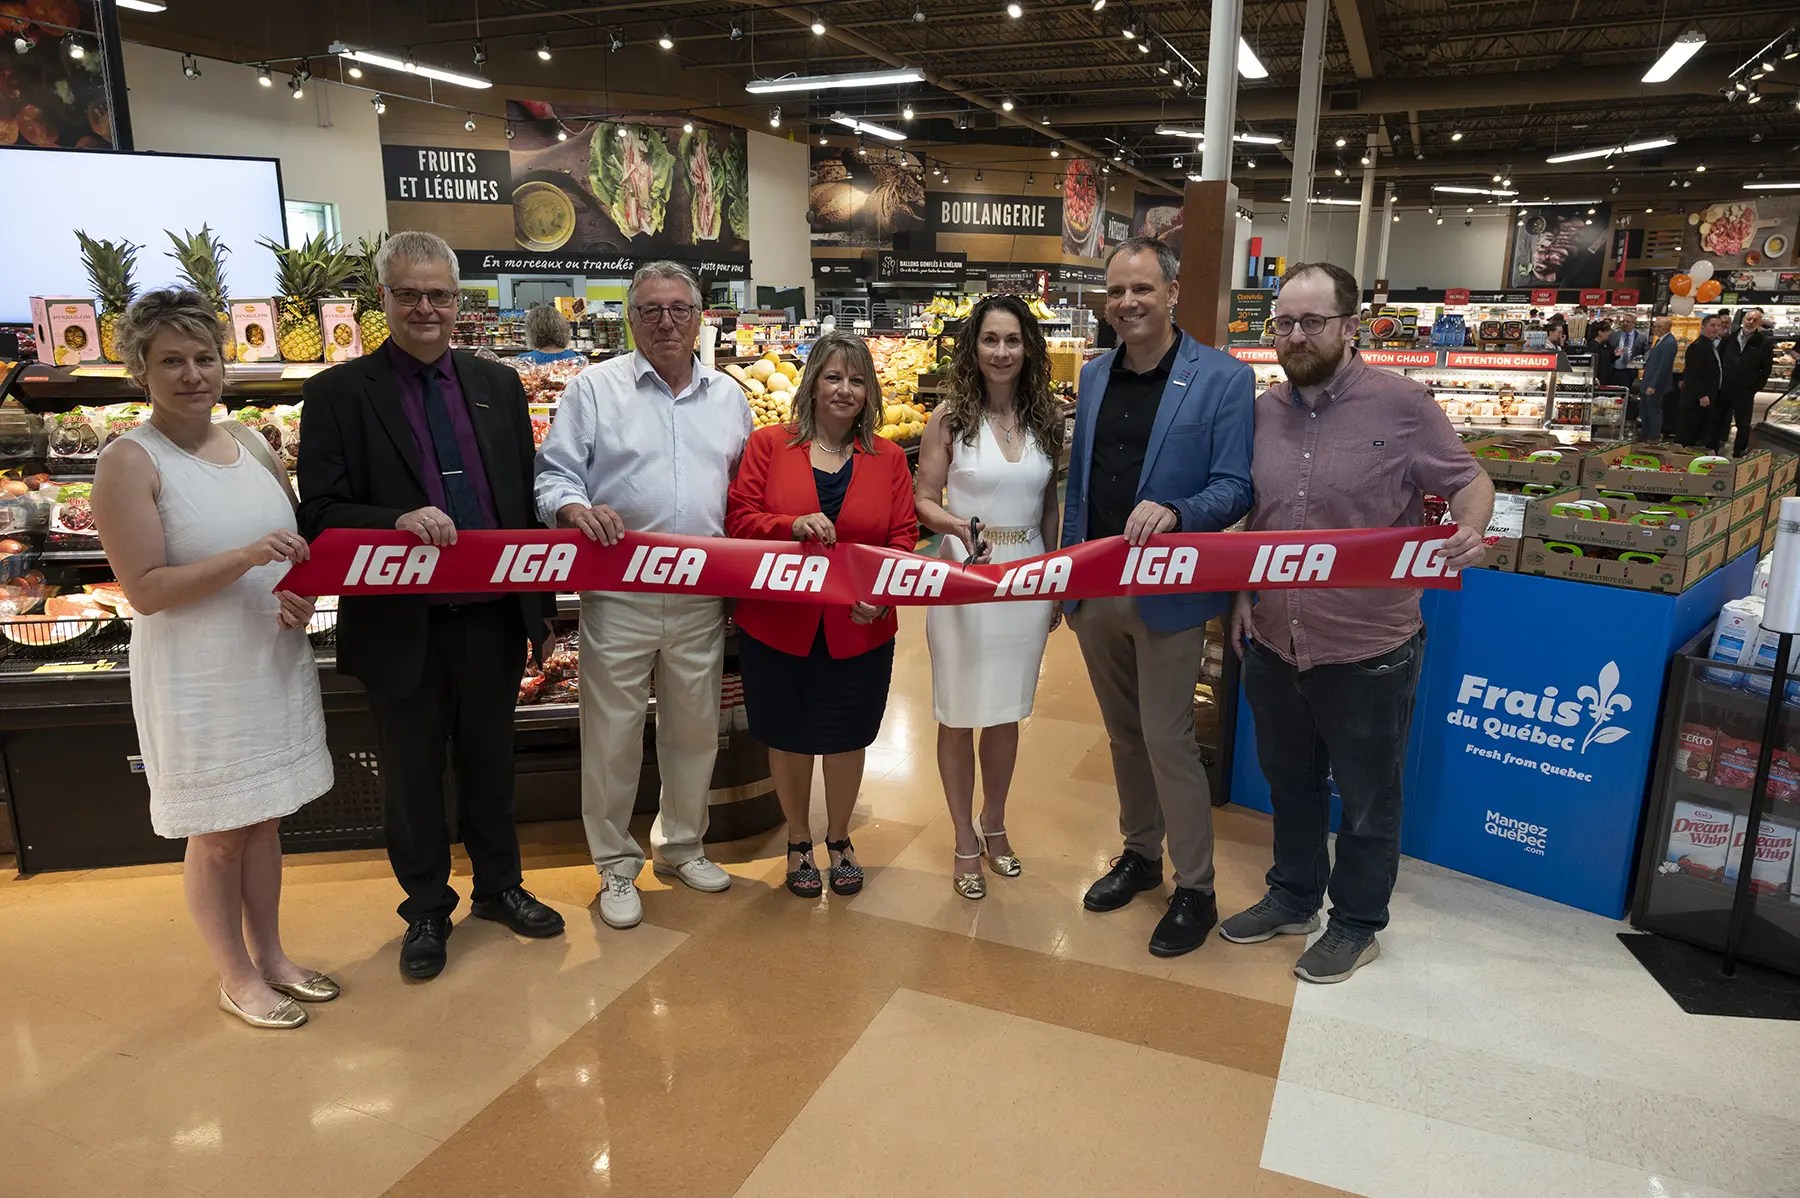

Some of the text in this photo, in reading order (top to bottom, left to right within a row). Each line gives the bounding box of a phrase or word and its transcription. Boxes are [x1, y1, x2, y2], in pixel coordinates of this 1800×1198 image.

[418, 150, 477, 173] FRUITS
[399, 174, 499, 201] ET LÉGUMES
[941, 201, 1045, 227] BOULANGERIE
[482, 255, 634, 271] En morceaux ou tranchés
[716, 262, 730, 276] pour
[731, 263, 745, 273] vous
[920, 259, 939, 268] GONFLÉS
[1236, 351, 1278, 359] ATTENTIO
[1397, 355, 1429, 363] CHAUD
[1455, 355, 1549, 366] ATTENTION CHAUD
[343, 545, 440, 586] IGA
[489, 543, 578, 583] IGA
[622, 545, 707, 586] IGA
[750, 552, 829, 592] IGA
[993, 556, 1073, 597] IGA
[1119, 546, 1199, 585] IGA
[1248, 544, 1337, 584] IGA
[871, 558, 950, 597] IGA
[1457, 674, 1583, 727] Frais
[1446, 708, 1576, 751] du Québec
[1680, 732, 1713, 746] CERTO
[1465, 743, 1593, 782] Fresh from Quebec
[1484, 821, 1547, 849] Québec
[1485, 809, 1548, 837] Mangez
[1672, 817, 1730, 833] Dream
[1523, 845, 1545, 856] .com
[1689, 832, 1728, 846] Whip
[1732, 831, 1793, 848] Deam
